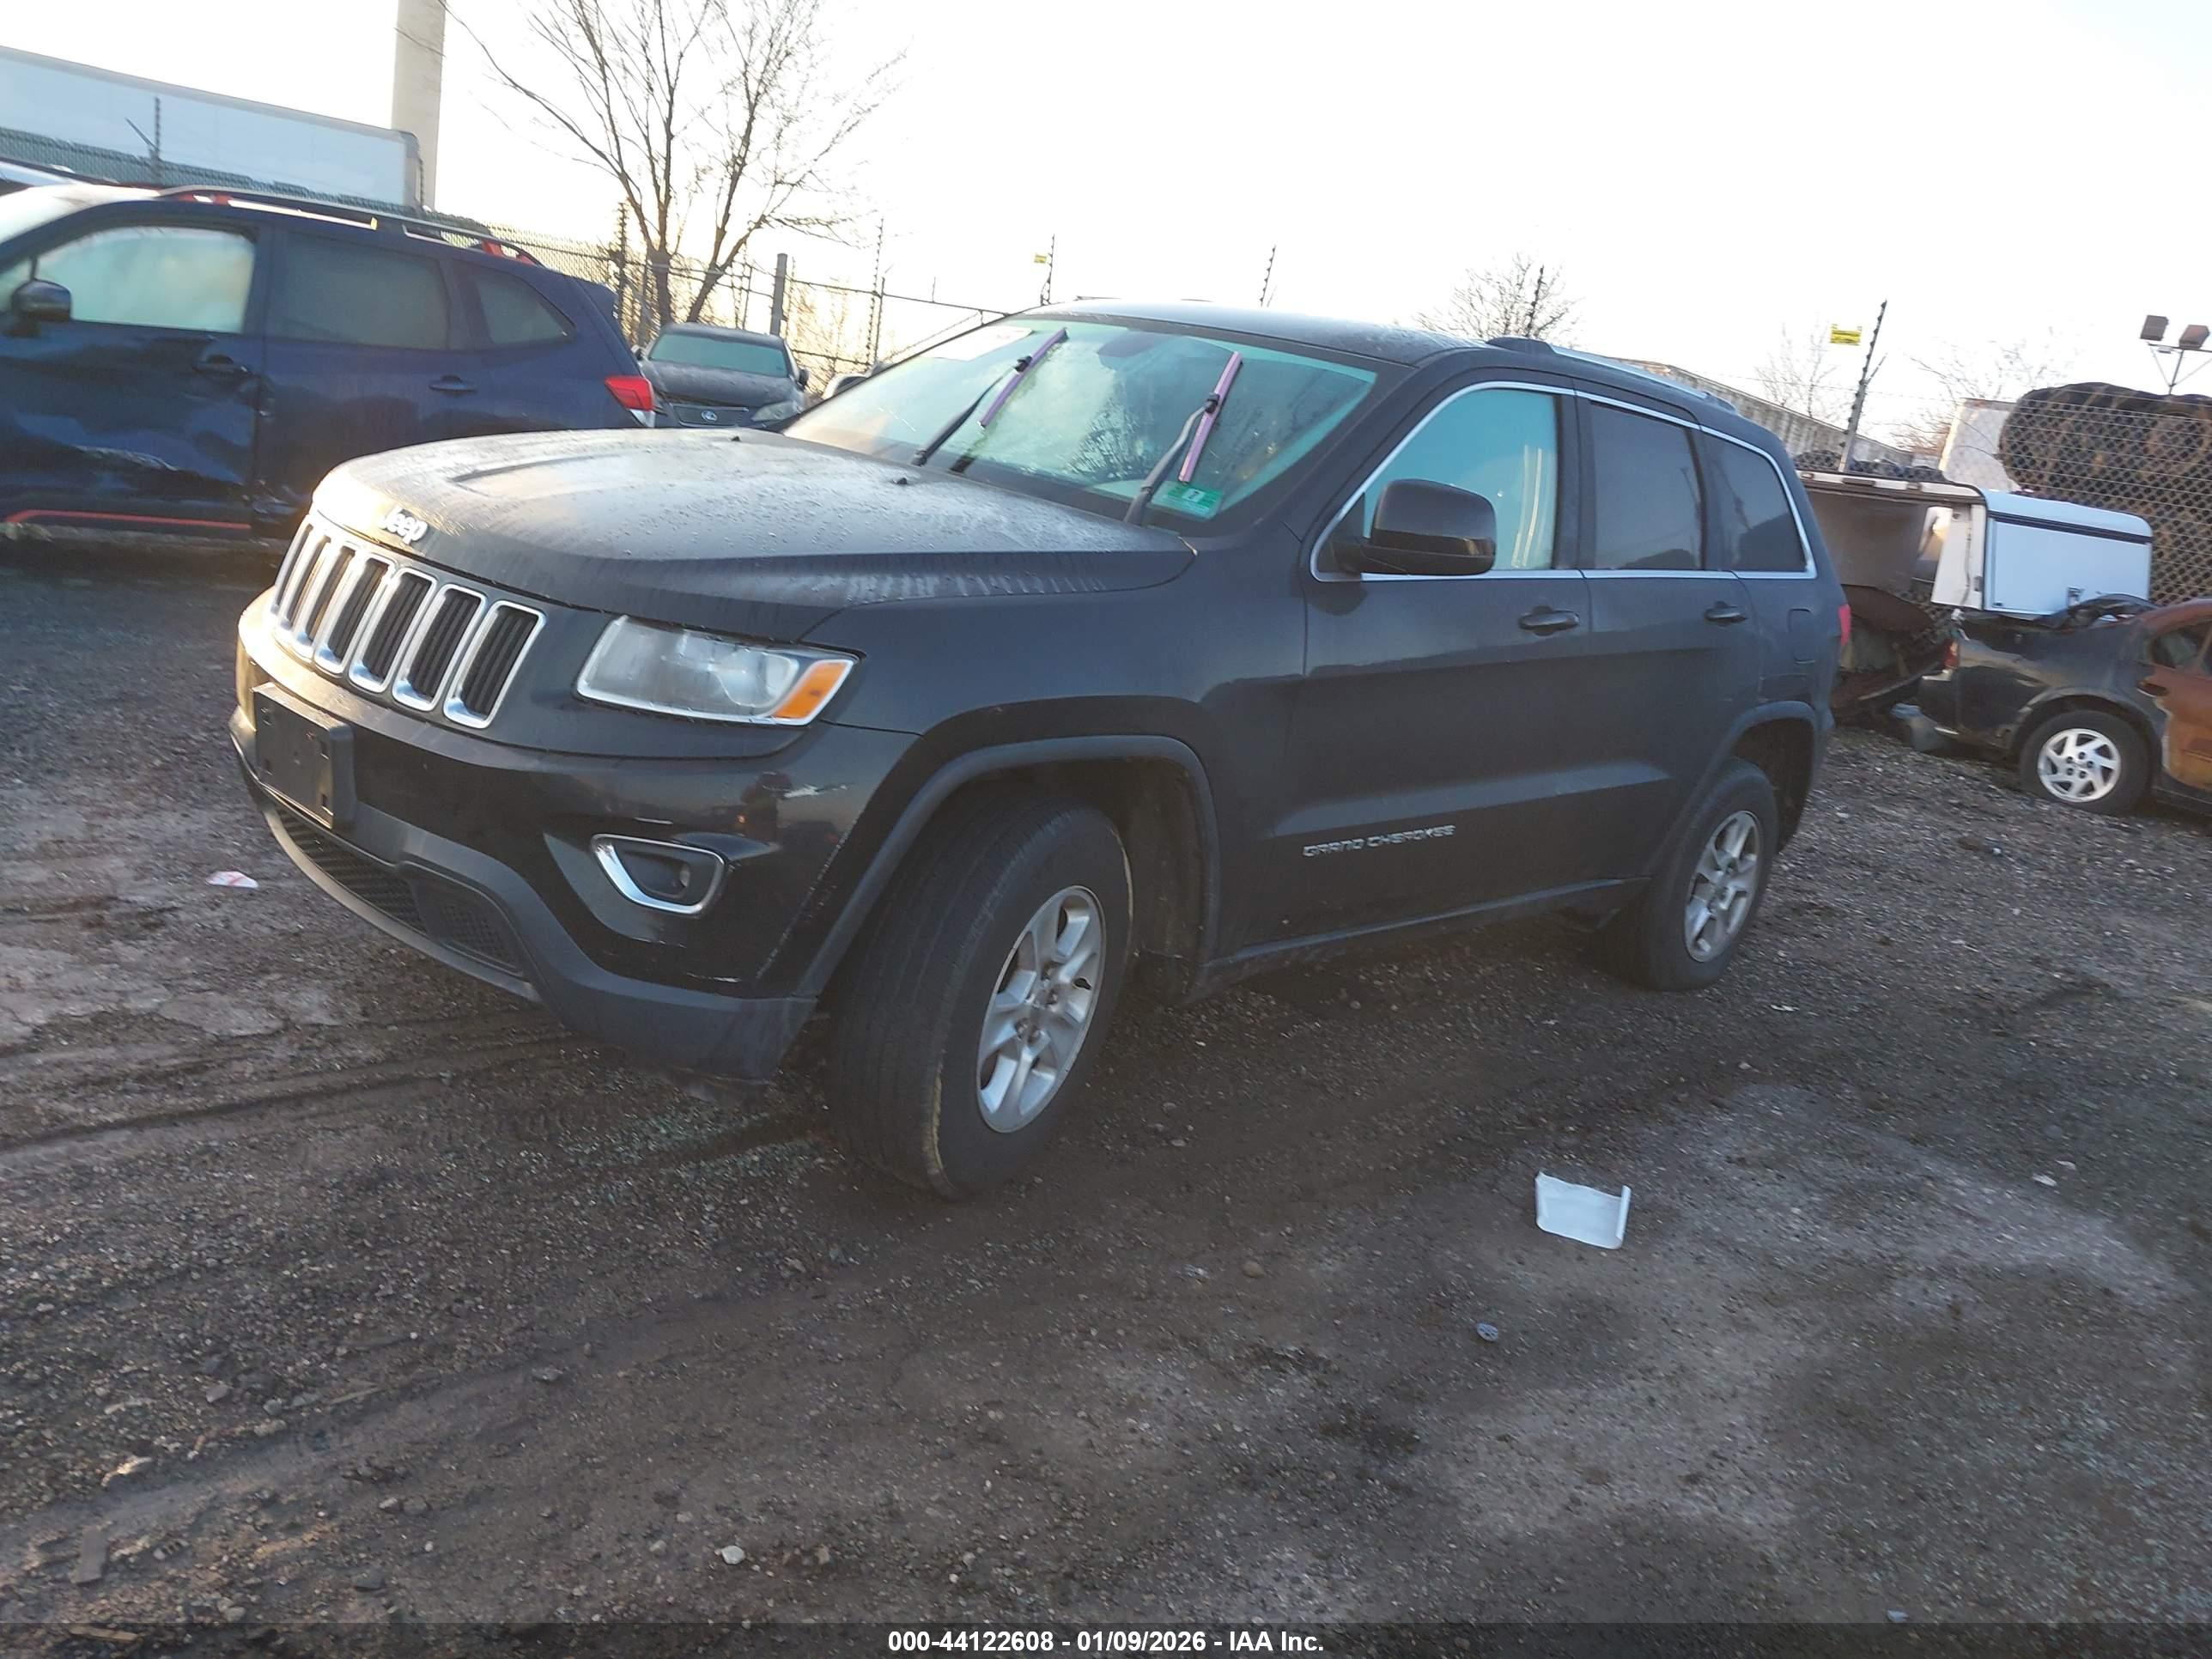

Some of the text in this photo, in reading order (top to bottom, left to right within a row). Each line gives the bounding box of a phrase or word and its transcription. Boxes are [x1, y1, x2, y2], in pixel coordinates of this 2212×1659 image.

[379, 504, 428, 544] Jeep
[1303, 824, 1456, 857] GRAND CHEROKEE
